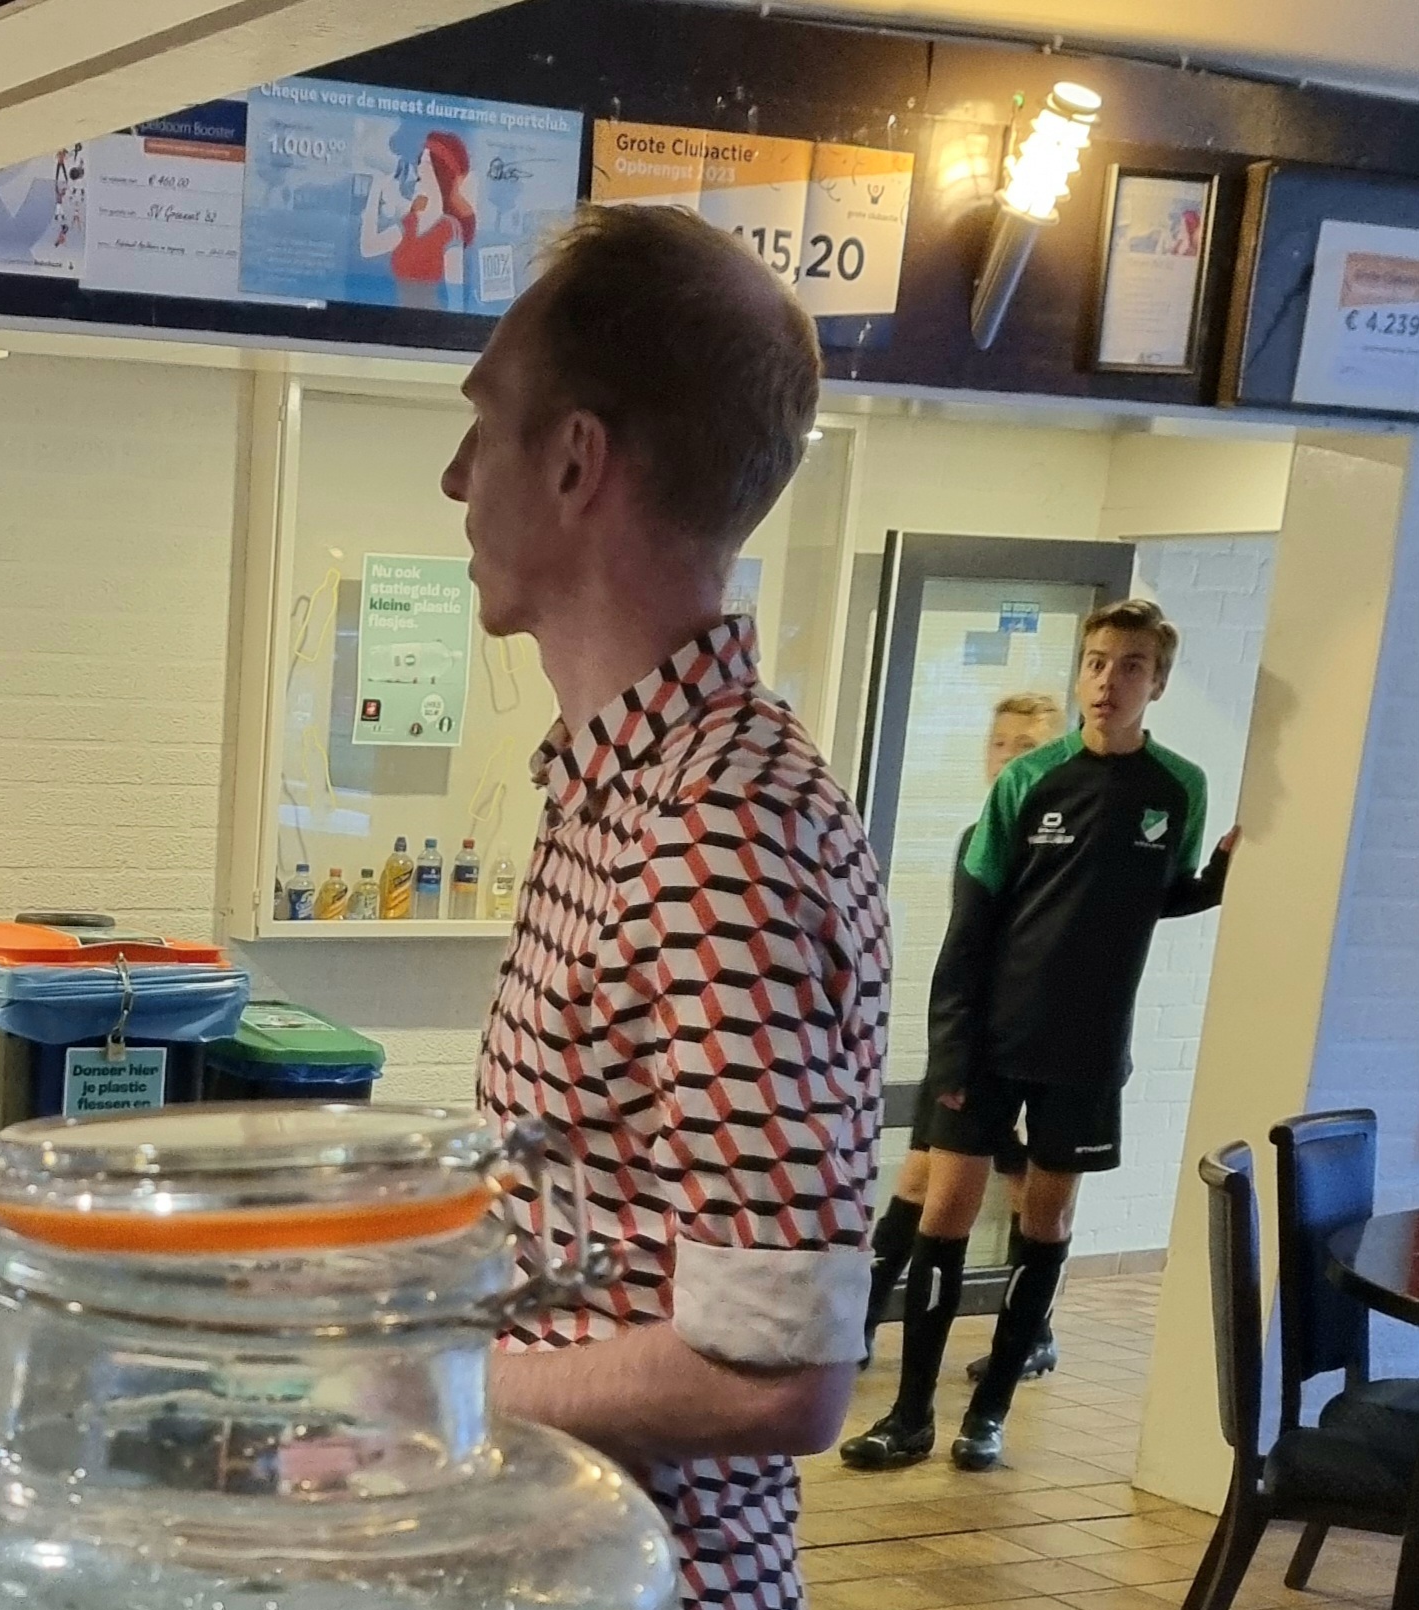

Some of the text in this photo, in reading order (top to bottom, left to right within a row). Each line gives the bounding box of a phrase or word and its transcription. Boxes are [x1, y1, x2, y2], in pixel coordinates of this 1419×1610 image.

[260, 82, 316, 104] Cheque
[321, 92, 352, 106] voor
[356, 90, 375, 107] de
[378, 97, 423, 115] meest
[426, 98, 497, 123] duurzame
[616, 133, 753, 162] Grote Clubactie
[615, 157, 693, 182] Opbrengst
[733, 225, 864, 284] 15,20
[372, 564, 421, 579] Nu ook
[370, 582, 460, 601] statiegeld op
[369, 597, 461, 615] kleine plastic
[368, 613, 418, 631] flesjes.
[73, 1063, 159, 1076] Doneer hier
[82, 1081, 147, 1096] je plastic
[77, 1096, 151, 1110] flessen en
